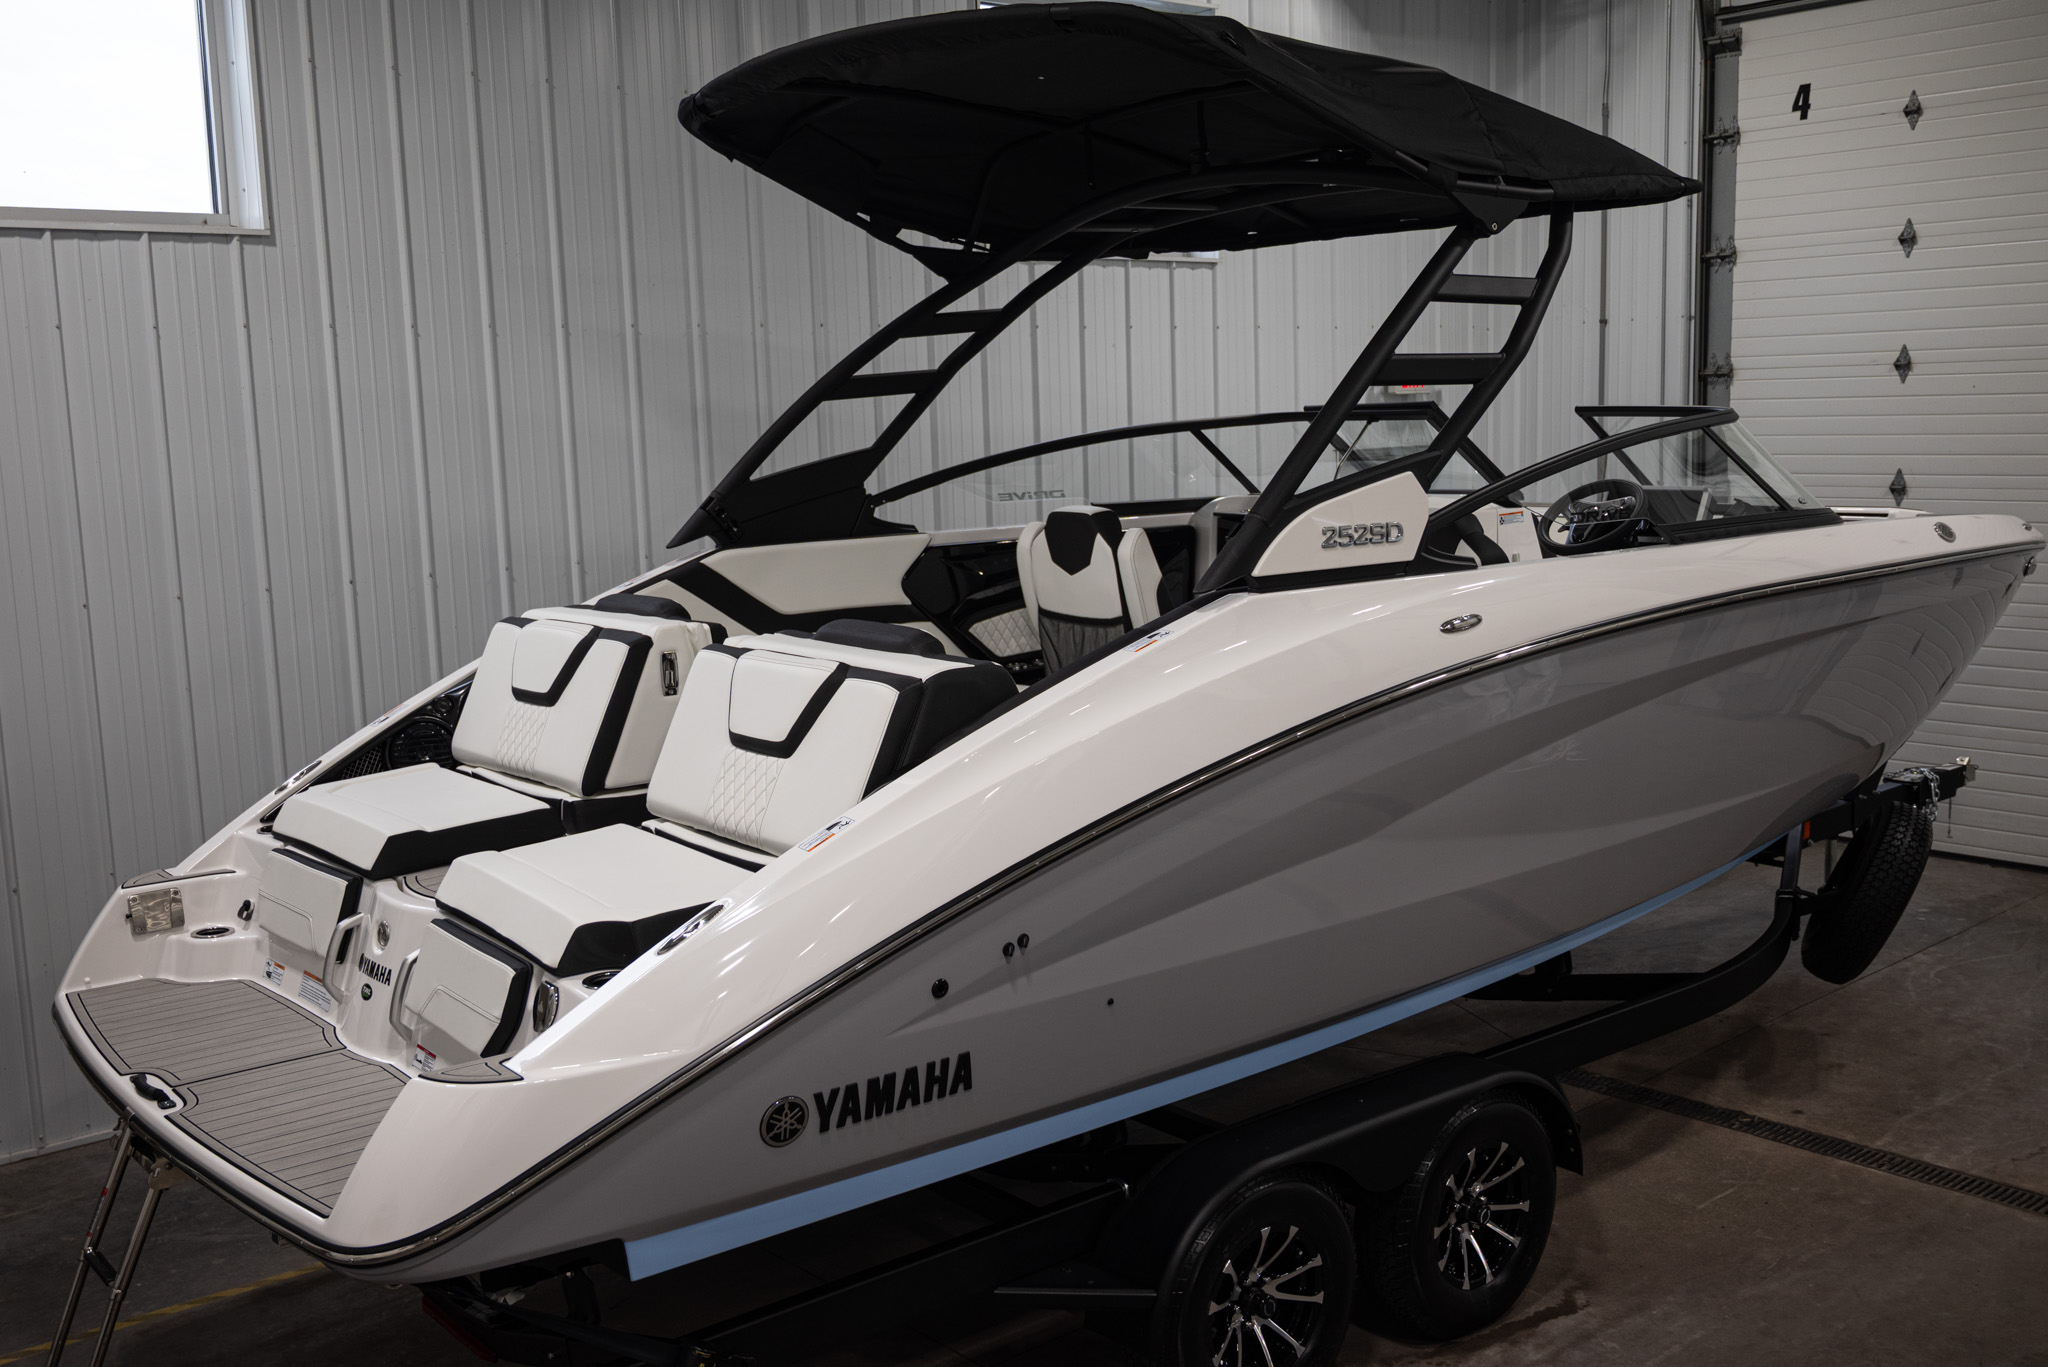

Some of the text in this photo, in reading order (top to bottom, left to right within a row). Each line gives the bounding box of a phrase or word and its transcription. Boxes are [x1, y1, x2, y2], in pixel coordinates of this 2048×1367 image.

[1792, 83, 1811, 120] 4
[1321, 521, 1404, 549] 252SD
[362, 956, 392, 986] YAMAHA
[813, 1050, 973, 1133] YAMAHA
